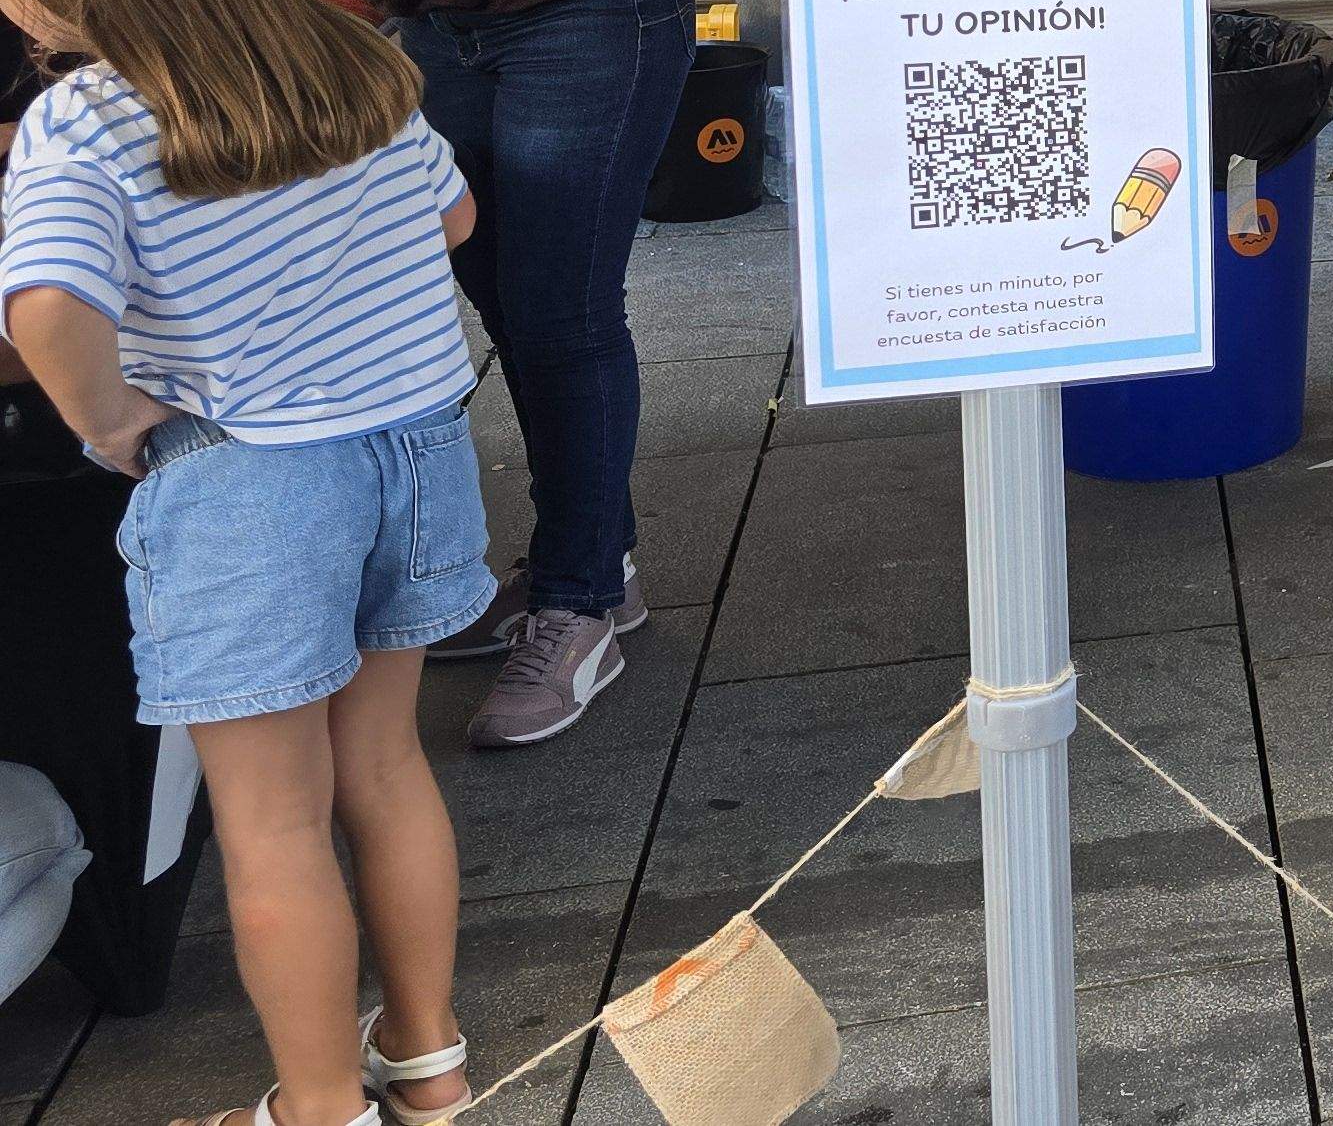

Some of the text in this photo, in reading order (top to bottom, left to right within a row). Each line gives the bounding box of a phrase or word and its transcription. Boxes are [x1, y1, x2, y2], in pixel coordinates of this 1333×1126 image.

[901, 0, 1105, 38] TU OPINIÓN!
[885, 271, 1104, 302] Si tienes un minuto, por
[886, 294, 1104, 325] favor, contesta nuestra
[877, 313, 1107, 348] encuesta de satisfacción
